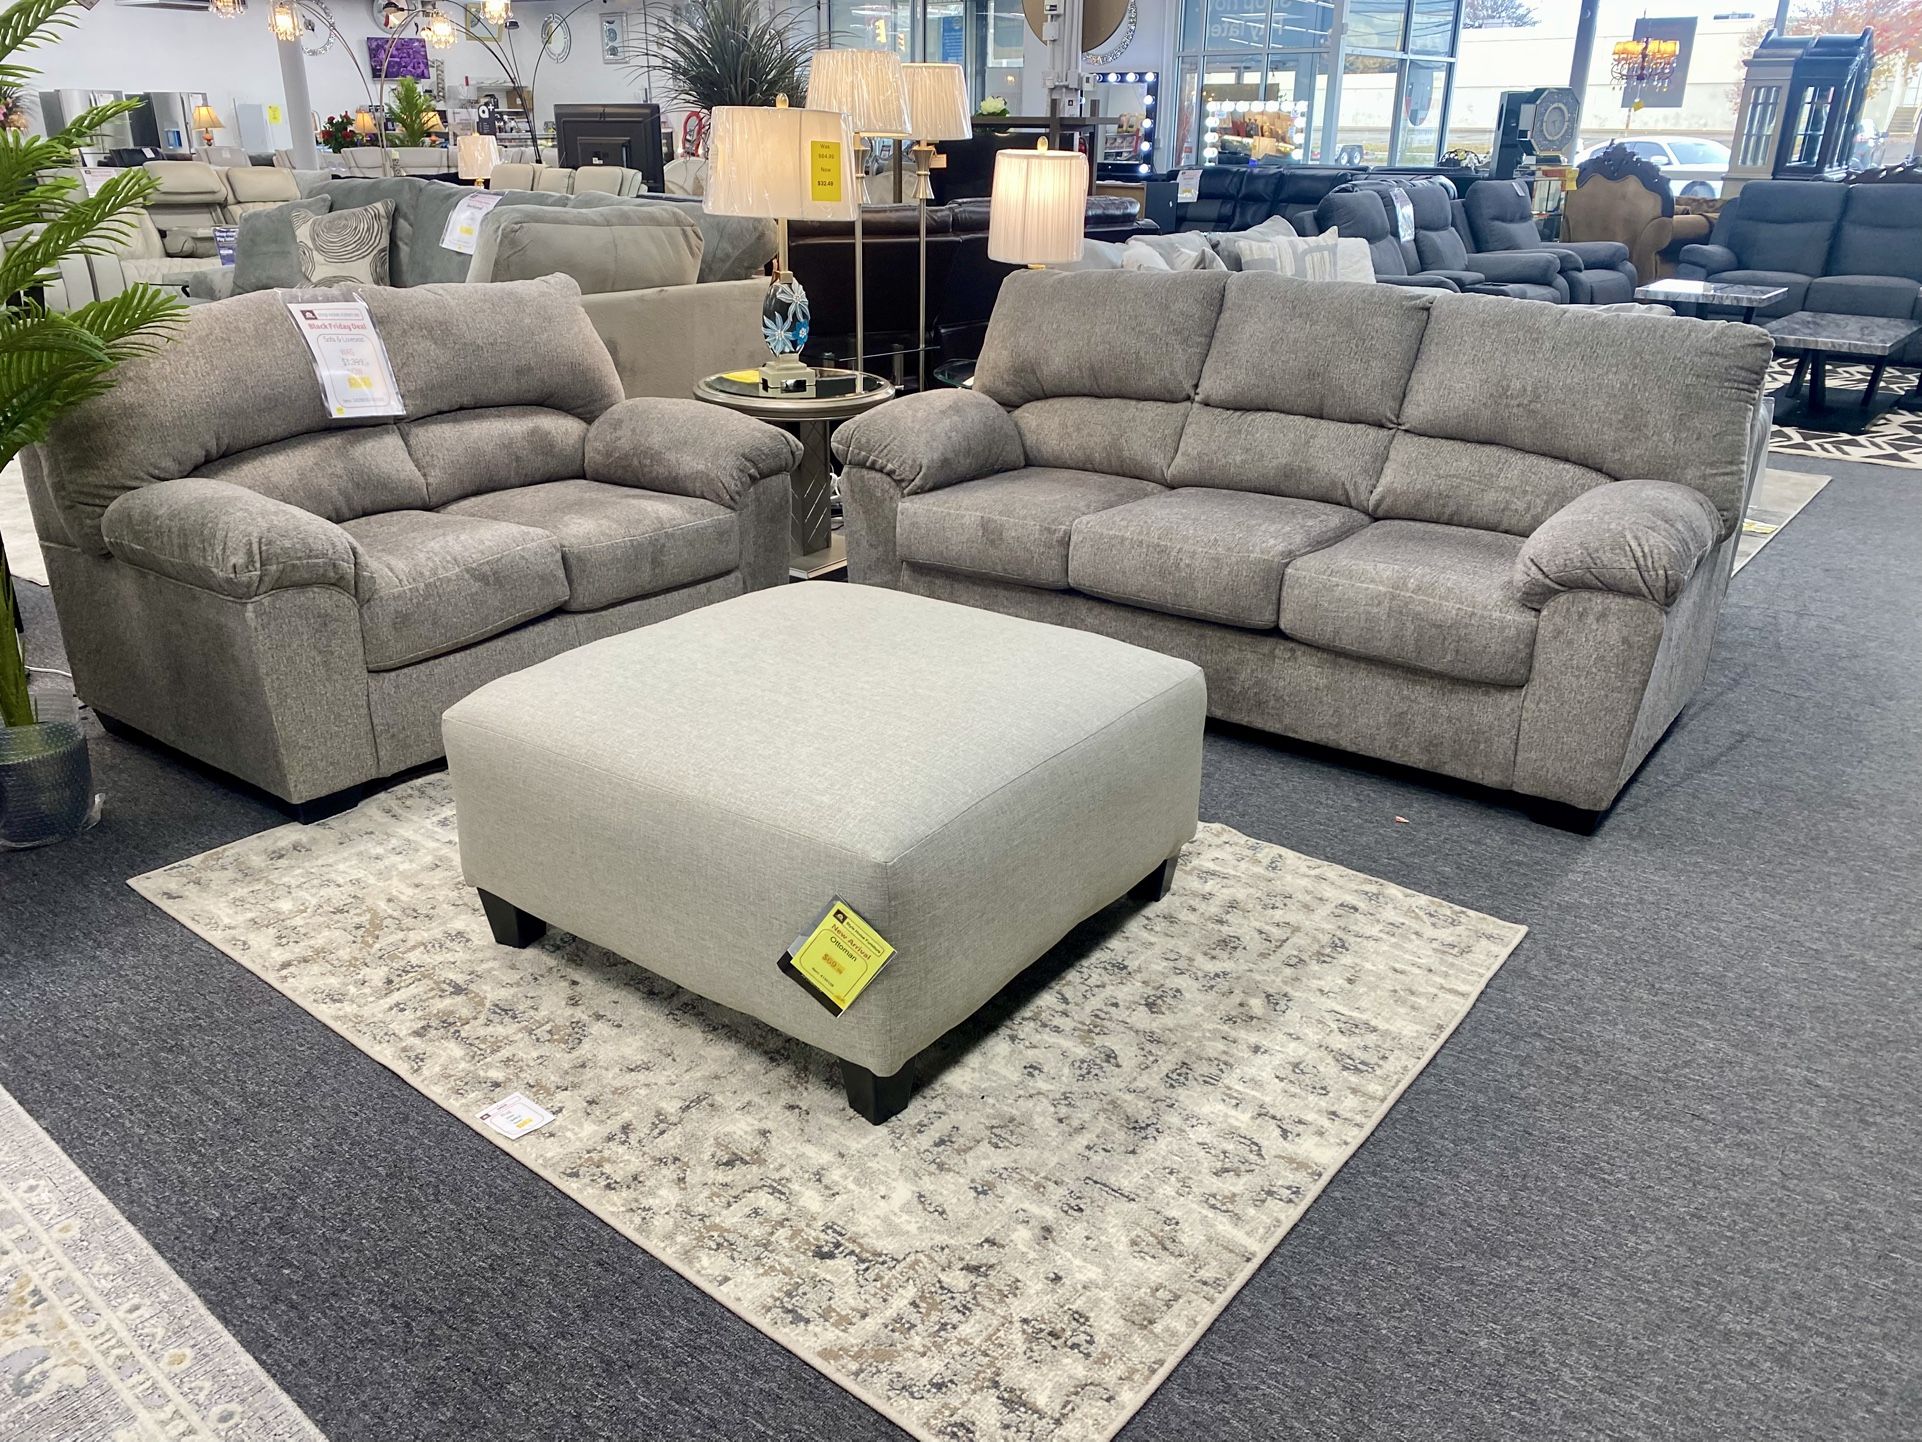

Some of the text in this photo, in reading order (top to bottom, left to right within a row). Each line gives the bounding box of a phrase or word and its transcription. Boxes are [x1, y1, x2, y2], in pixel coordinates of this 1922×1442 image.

[328, 323, 352, 331] Friday
[830, 936, 857, 962] Ottoman
[831, 924, 872, 960] New Arrival
